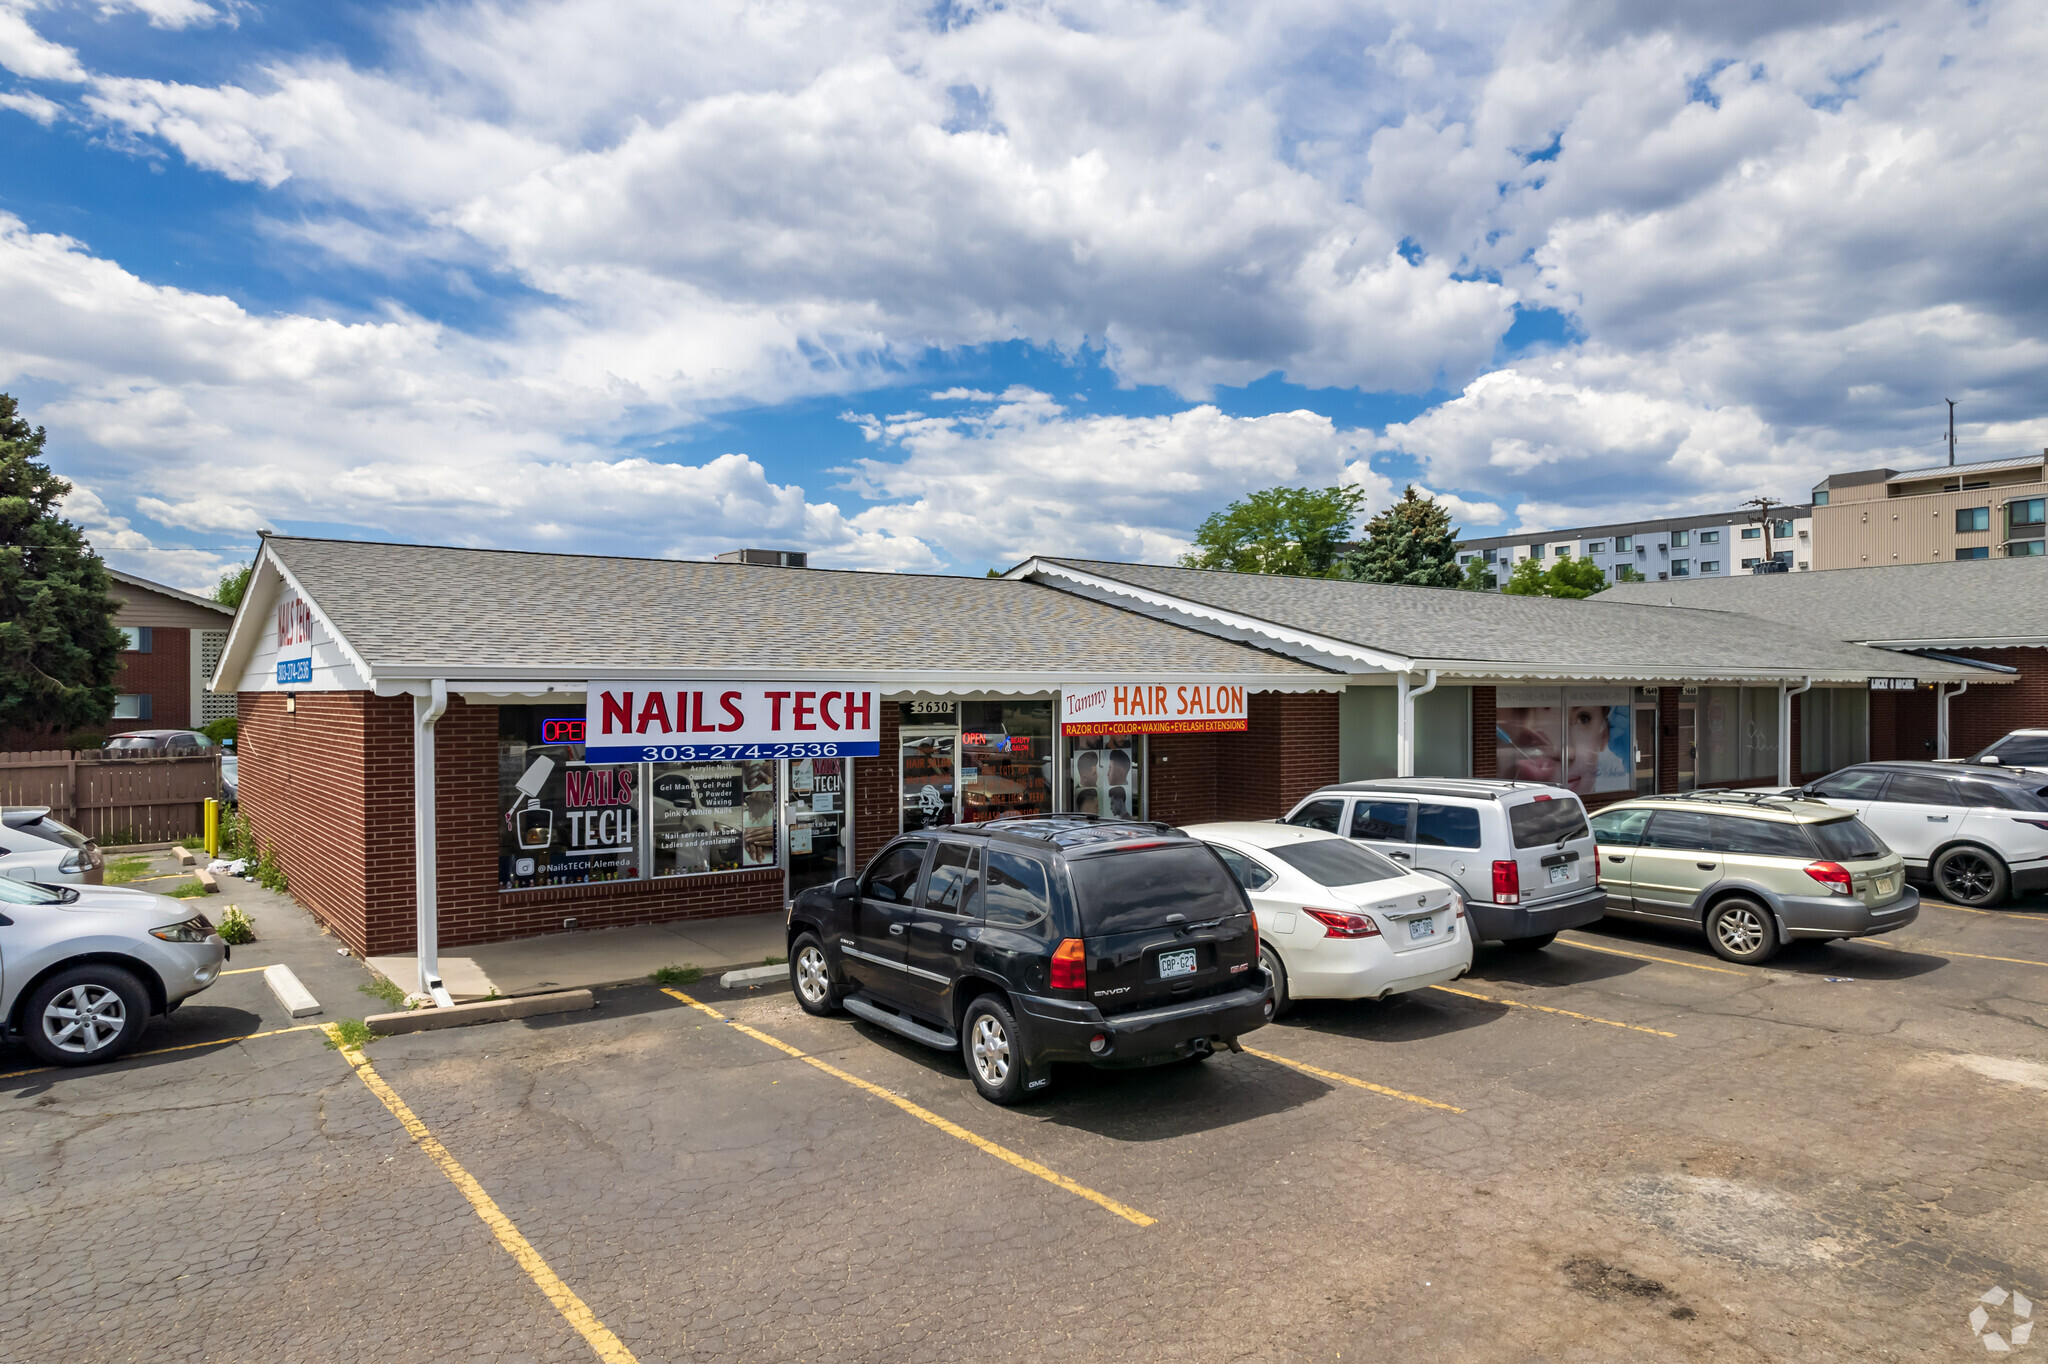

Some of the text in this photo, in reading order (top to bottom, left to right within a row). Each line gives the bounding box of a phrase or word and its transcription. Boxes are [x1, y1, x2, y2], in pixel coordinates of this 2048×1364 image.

[278, 601, 294, 647] NAILS
[278, 661, 309, 681] 303-274-2536
[1872, 678, 1888, 690] LUCKY
[1896, 679, 1914, 690] ARCADE
[1066, 689, 1107, 715] Tammy
[1114, 686, 1243, 716] HAIR SALON
[600, 690, 871, 734] NAILS TECH
[917, 702, 949, 713] 5630
[1066, 720, 1245, 734] RAZOR CUT COLOR WAXING EYELASH EXTENSIONS
[962, 732, 986, 744] OPEN
[1010, 736, 1030, 744] BEAUTY
[642, 743, 838, 761] 303-274-2536
[690, 765, 714, 773] Acrylic
[906, 758, 952, 768] HAIR SALON
[1000, 765, 1014, 776] CUTS
[566, 770, 632, 807] NAILS
[814, 776, 840, 792] TECH
[691, 792, 703, 800] Dip
[664, 810, 680, 818] pink
[691, 808, 712, 816] White
[566, 809, 632, 846] TECH
[681, 831, 708, 840] services
[662, 841, 683, 849] Ladies
[686, 840, 698, 848] and
[538, 859, 631, 874] @NailsTECH.Alemeda
[1230, 962, 1248, 974] GMC
[1094, 986, 1131, 996] ENVOY
[1028, 1078, 1046, 1088] GMC
